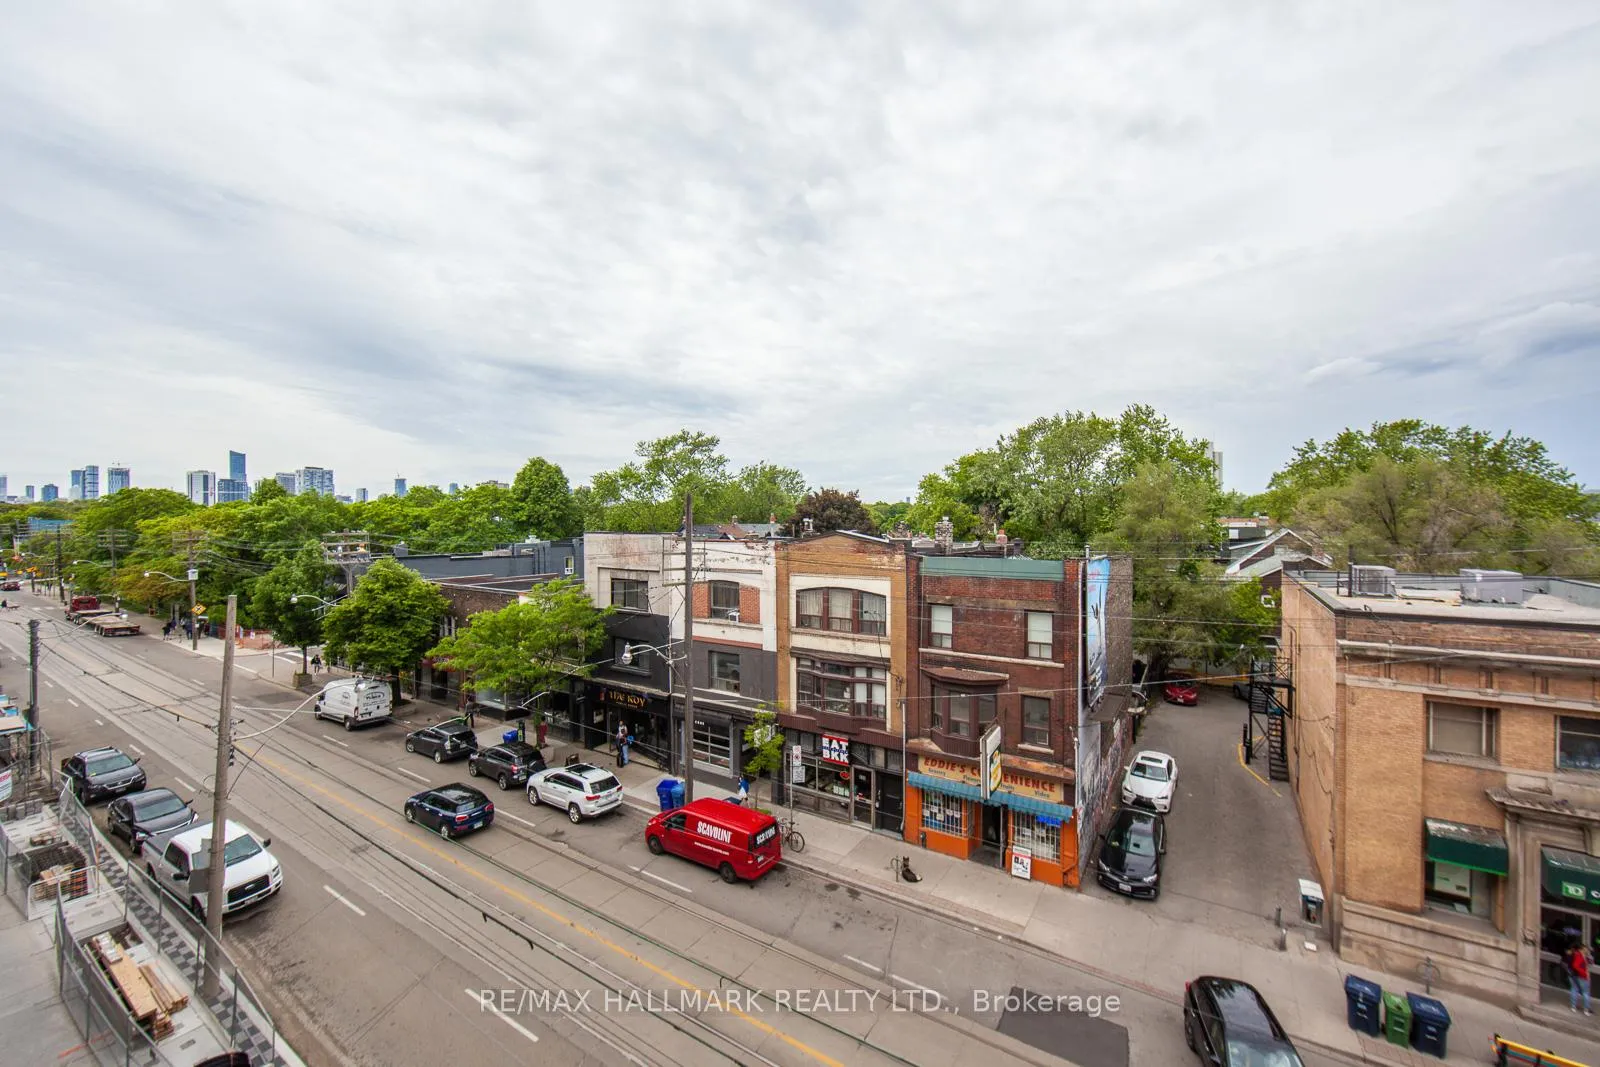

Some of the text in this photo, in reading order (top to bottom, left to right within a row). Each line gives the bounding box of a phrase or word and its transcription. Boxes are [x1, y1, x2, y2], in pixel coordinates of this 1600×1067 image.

[822, 737, 848, 750] EAT
[924, 757, 966, 773] EDDIE'S
[971, 766, 1055, 793] CENIENCE
[697, 820, 733, 844] SCAVOLINI
